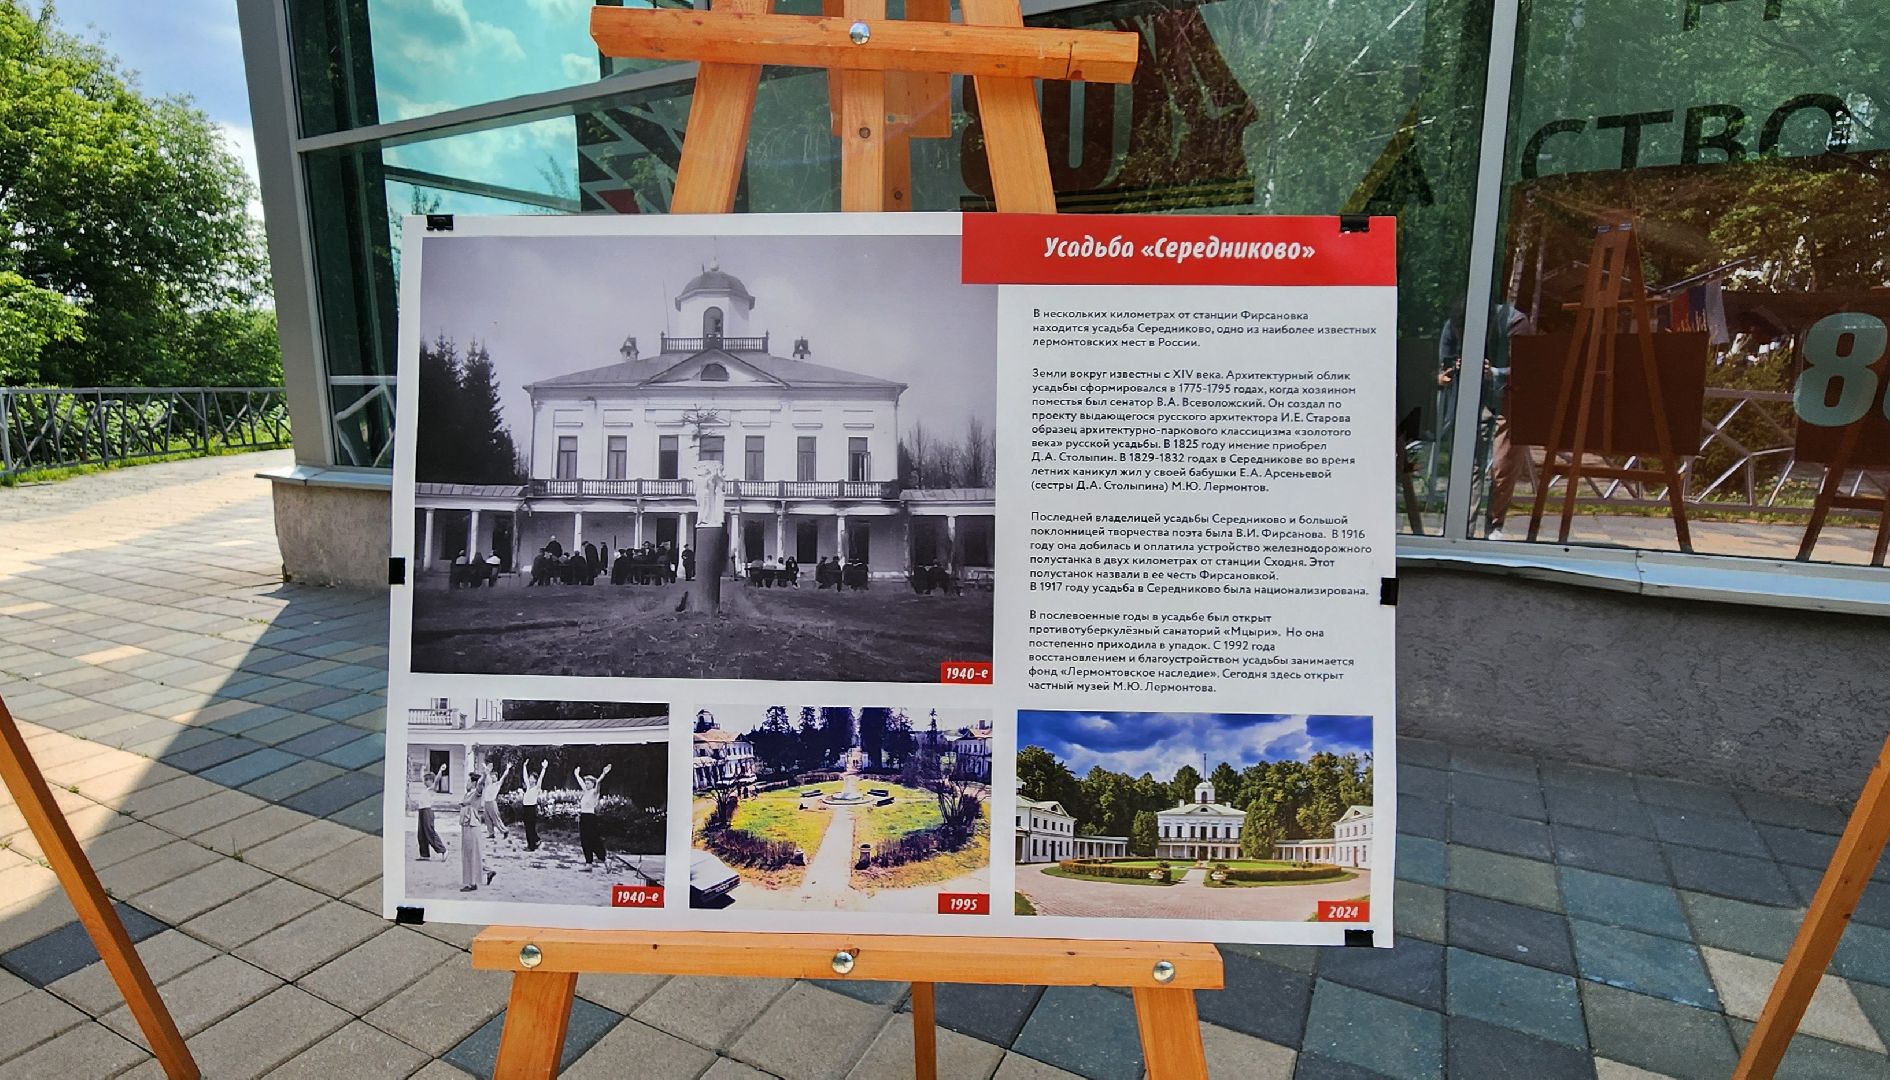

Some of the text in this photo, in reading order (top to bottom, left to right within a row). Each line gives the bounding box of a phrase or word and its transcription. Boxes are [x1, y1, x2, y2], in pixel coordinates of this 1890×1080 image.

[1044, 235, 1316, 264] Усадьба «Середниково»
[1033, 308, 1040, 317] В
[1109, 311, 1175, 321] километрах
[1192, 312, 1238, 320] станции
[1240, 310, 1308, 322] Фирсановка
[1032, 322, 1376, 336] находится усадьба Середниково, одно наиболее известных
[1032, 338, 1118, 348] лермонтовских
[1157, 336, 1200, 347] России.
[1032, 367, 1351, 383] Земли вокруг известны XIV века. Архитектурный облик
[1793, 312, 1890, 427] 8
[1031, 381, 1356, 395] усадьбы сформировался 1775-1795 годах, когда хозяином
[1083, 396, 1107, 406] был
[1109, 398, 1154, 409] сенатор
[1156, 396, 1180, 407] В.А.
[1181, 396, 1266, 408] Всеволожский.
[1267, 397, 1284, 408] Он
[1286, 400, 1325, 409] создал
[1031, 411, 1350, 425] проекту выдающегося русского архитектора И.Е. Старова
[1031, 423, 1077, 436] образец
[1079, 426, 1218, 439] архитектурно-паркового
[1220, 428, 1291, 437] классицизма
[1065, 438, 1110, 450] русской
[1112, 437, 1161, 452] усадьбы.
[1163, 438, 1171, 448] В
[1173, 438, 1199, 449] 1825
[1200, 441, 1226, 452] году
[1272, 440, 1327, 453] приобрел
[1030, 451, 1355, 467] Д.А. Столыпин. В 1829-1832 годах Середникове время
[1072, 468, 1117, 478] каникул
[1119, 468, 1142, 477] жил
[1153, 466, 1186, 476] своей
[1188, 467, 1237, 480] бабушки
[1239, 467, 1262, 477] Е.А.
[1263, 467, 1331, 480] Арсеньевой
[1030, 480, 1269, 495] (сестры Д.А. Столыпина) М.Ю. Лермонтов.
[1031, 510, 1348, 527] Последней владелицей усадьбы Середниково большой
[1030, 525, 1365, 541] поклонницей творчества поэта была В.И. Фирсанова. В 1916
[1029, 540, 1372, 556] году она добилась оплатила устройство железнодорожного
[1029, 556, 1335, 568] полустанка двух километрах от станции Сходня. Этот
[1029, 569, 1279, 583] полустанок назвали ее честь Фирсановкой.
[1029, 581, 1369, 598] В 1917 году усадьба Середниково была национализирована.
[1029, 609, 1272, 624] В послевоенные годы усадьбе был открыт
[1029, 623, 1160, 638] противотуберкулёзный
[1162, 625, 1220, 639] санаторий
[1222, 626, 1281, 639] «Мцыри».
[1285, 626, 1303, 637] Но
[1028, 639, 1275, 652] постепенно приходила упадок. С 1992 года
[1028, 653, 1354, 667] восстановлением благоустройством усадьбы занимается
[946, 667, 989, 680] 1940-е
[1028, 665, 1344, 682] фонд «Лермонтовское наследие». Сегодня здесь открыт
[1028, 679, 1216, 694] частный музей М.Ю. Лермонтова.
[617, 891, 659, 904] 1940-е
[950, 898, 978, 911] 1995
[1328, 906, 1359, 919] 2024
